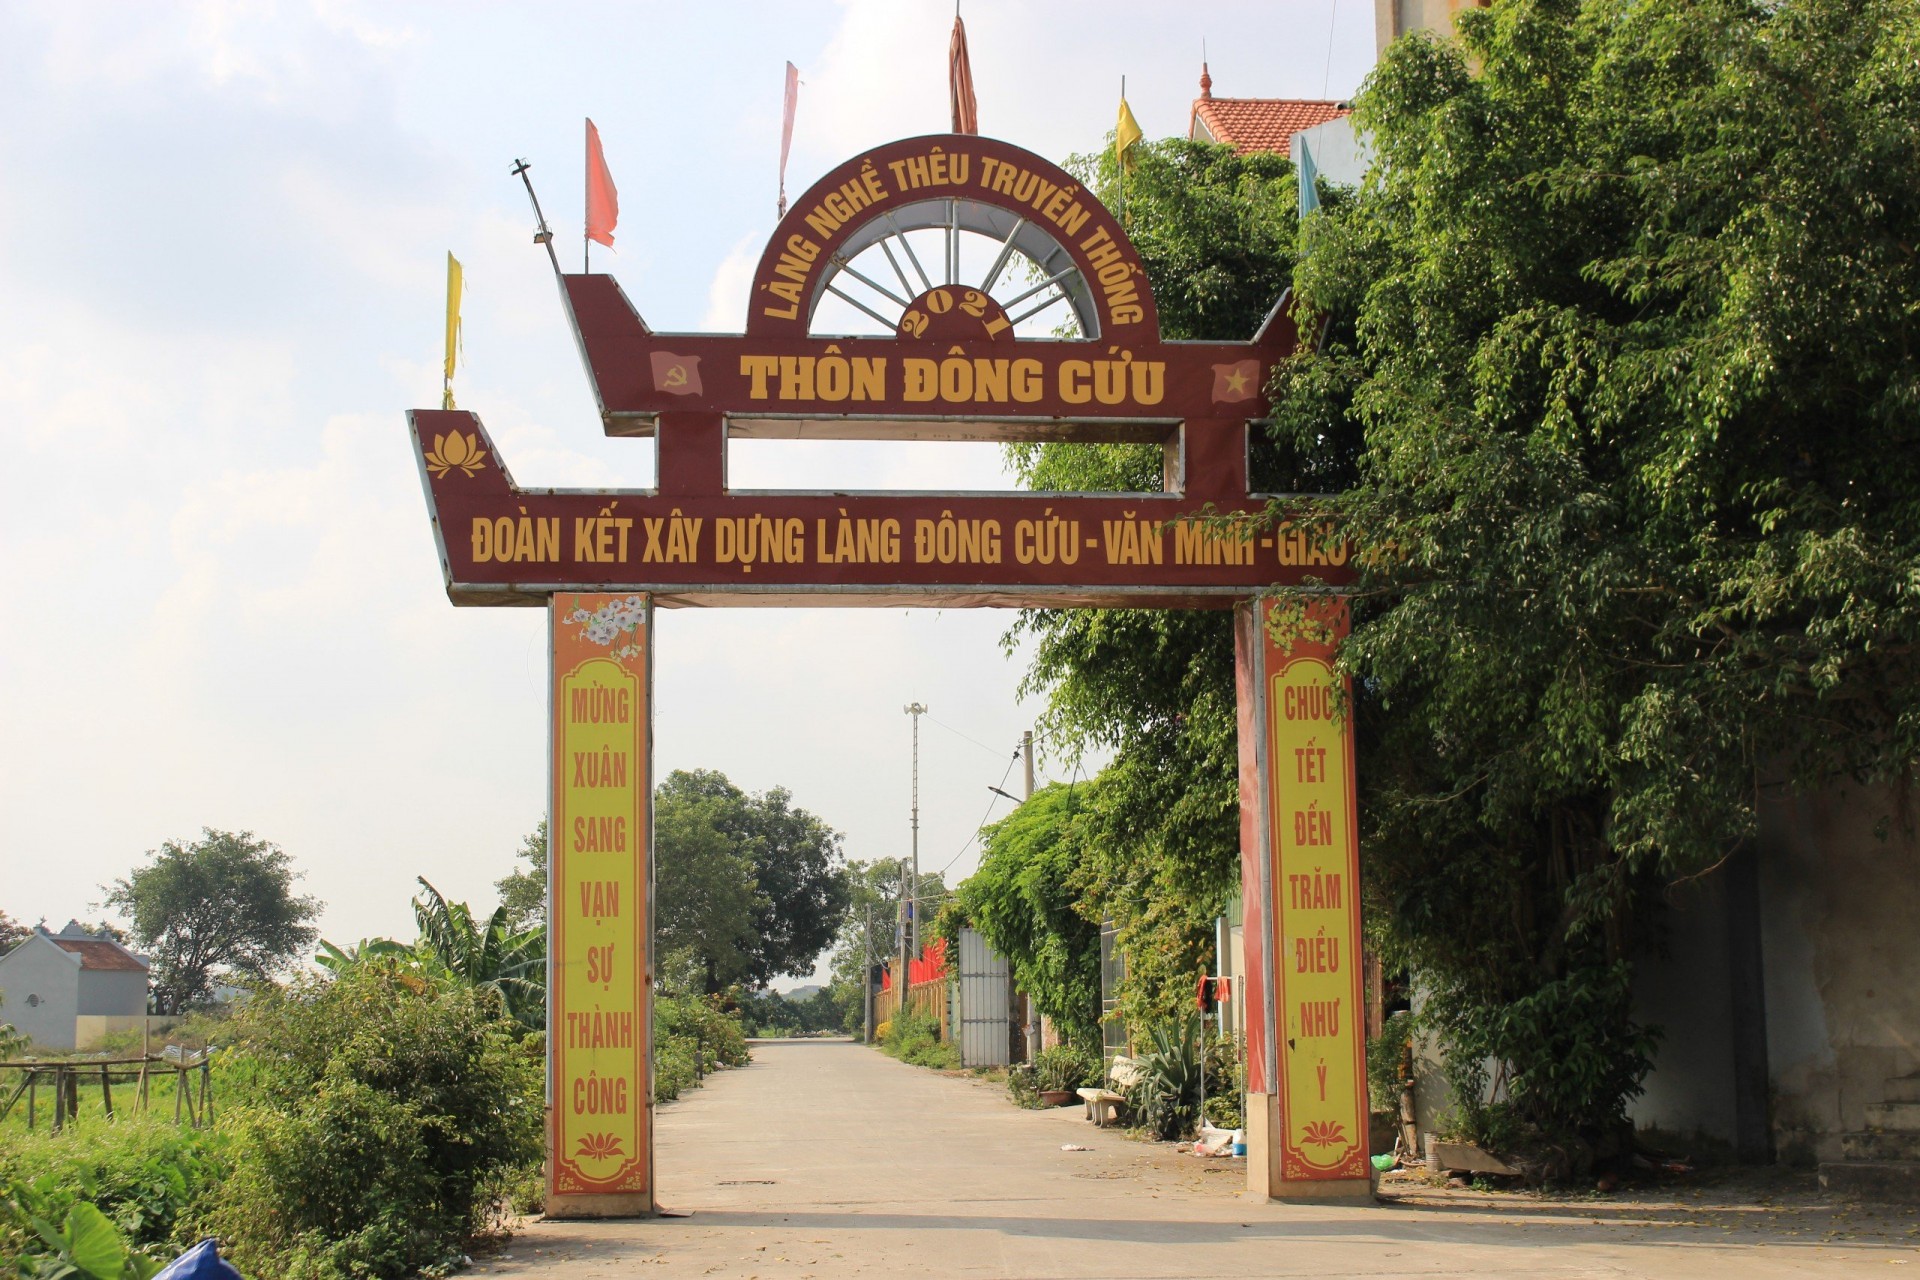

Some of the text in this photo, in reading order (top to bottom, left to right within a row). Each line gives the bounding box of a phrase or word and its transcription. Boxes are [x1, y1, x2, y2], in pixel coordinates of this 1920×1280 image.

[764, 146, 1143, 325] LÀNG NGHỀ THÊU TRUYỀN THỐNG
[902, 290, 1010, 341] 2021
[740, 344, 1165, 405] THÔN ĐÔNG CỨU
[471, 506, 560, 563] ĐOÀN
[575, 501, 632, 563] KẾT
[642, 508, 703, 563] XÂY
[716, 513, 804, 573] DỰNG
[817, 508, 900, 563] LÀNG
[914, 510, 1000, 564] ĐÔNG
[1015, 508, 1079, 564] CỨU
[1103, 510, 1163, 565] VĂN
[1175, 520, 1254, 565] MINH
[571, 680, 629, 724] MỪNG
[1284, 678, 1334, 721] CHÚC
[573, 744, 626, 788] XUÂN
[1295, 736, 1326, 783] TẾT
[574, 816, 626, 853] SANG
[1294, 799, 1332, 846] ĐẾN
[580, 881, 619, 926] VẠN
[1289, 866, 1342, 910] TRĂM
[587, 942, 614, 991] SỰ
[1296, 926, 1338, 973] ĐIỀU
[567, 1004, 632, 1049] THÀNH
[1300, 998, 1340, 1037] NHƯ
[573, 1070, 627, 1115] CÔNG
[1316, 1058, 1327, 1102] Ý
